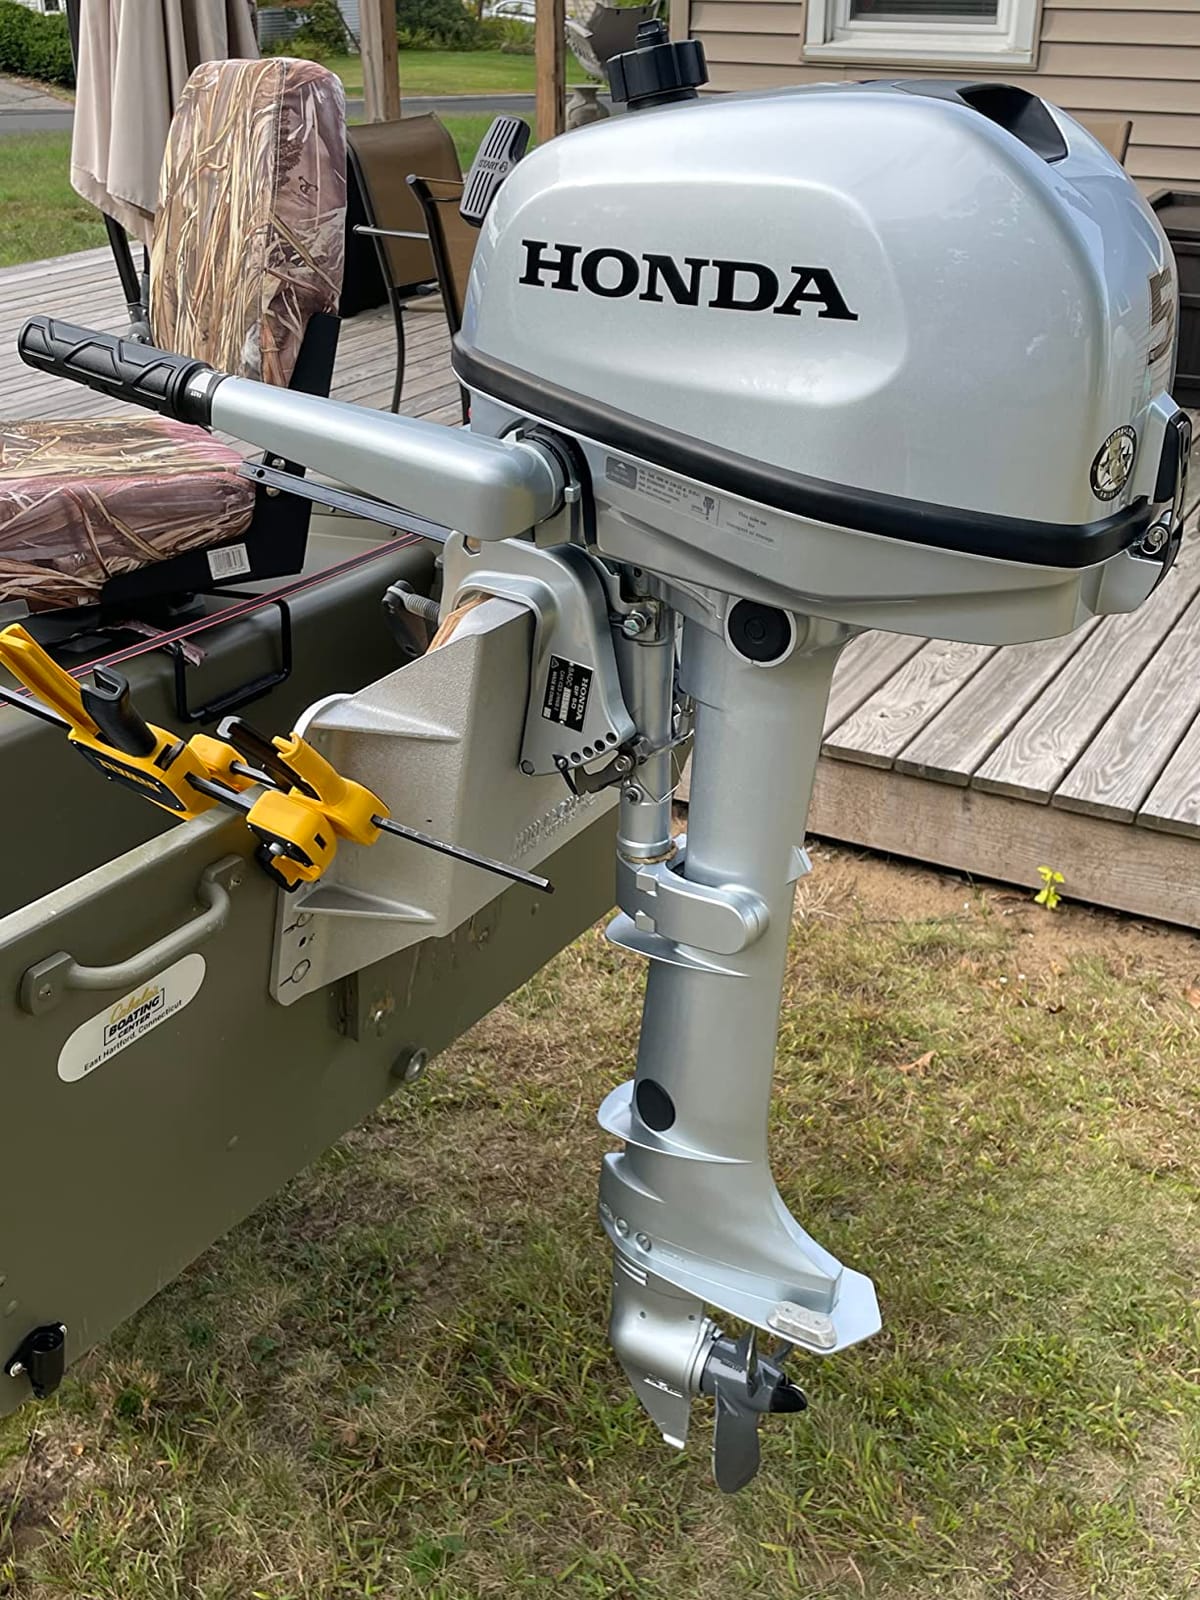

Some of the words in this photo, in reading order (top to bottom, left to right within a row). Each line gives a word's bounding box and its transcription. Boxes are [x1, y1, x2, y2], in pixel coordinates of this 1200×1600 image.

[478, 160, 499, 170] START
[519, 239, 858, 320] HONDA
[576, 678, 588, 720] HONDA
[84, 1055, 102, 1071] East
[138, 1000, 182, 1033] Connecticut
[109, 996, 160, 1037] BOATING
[118, 1012, 150, 1038] CENTER
